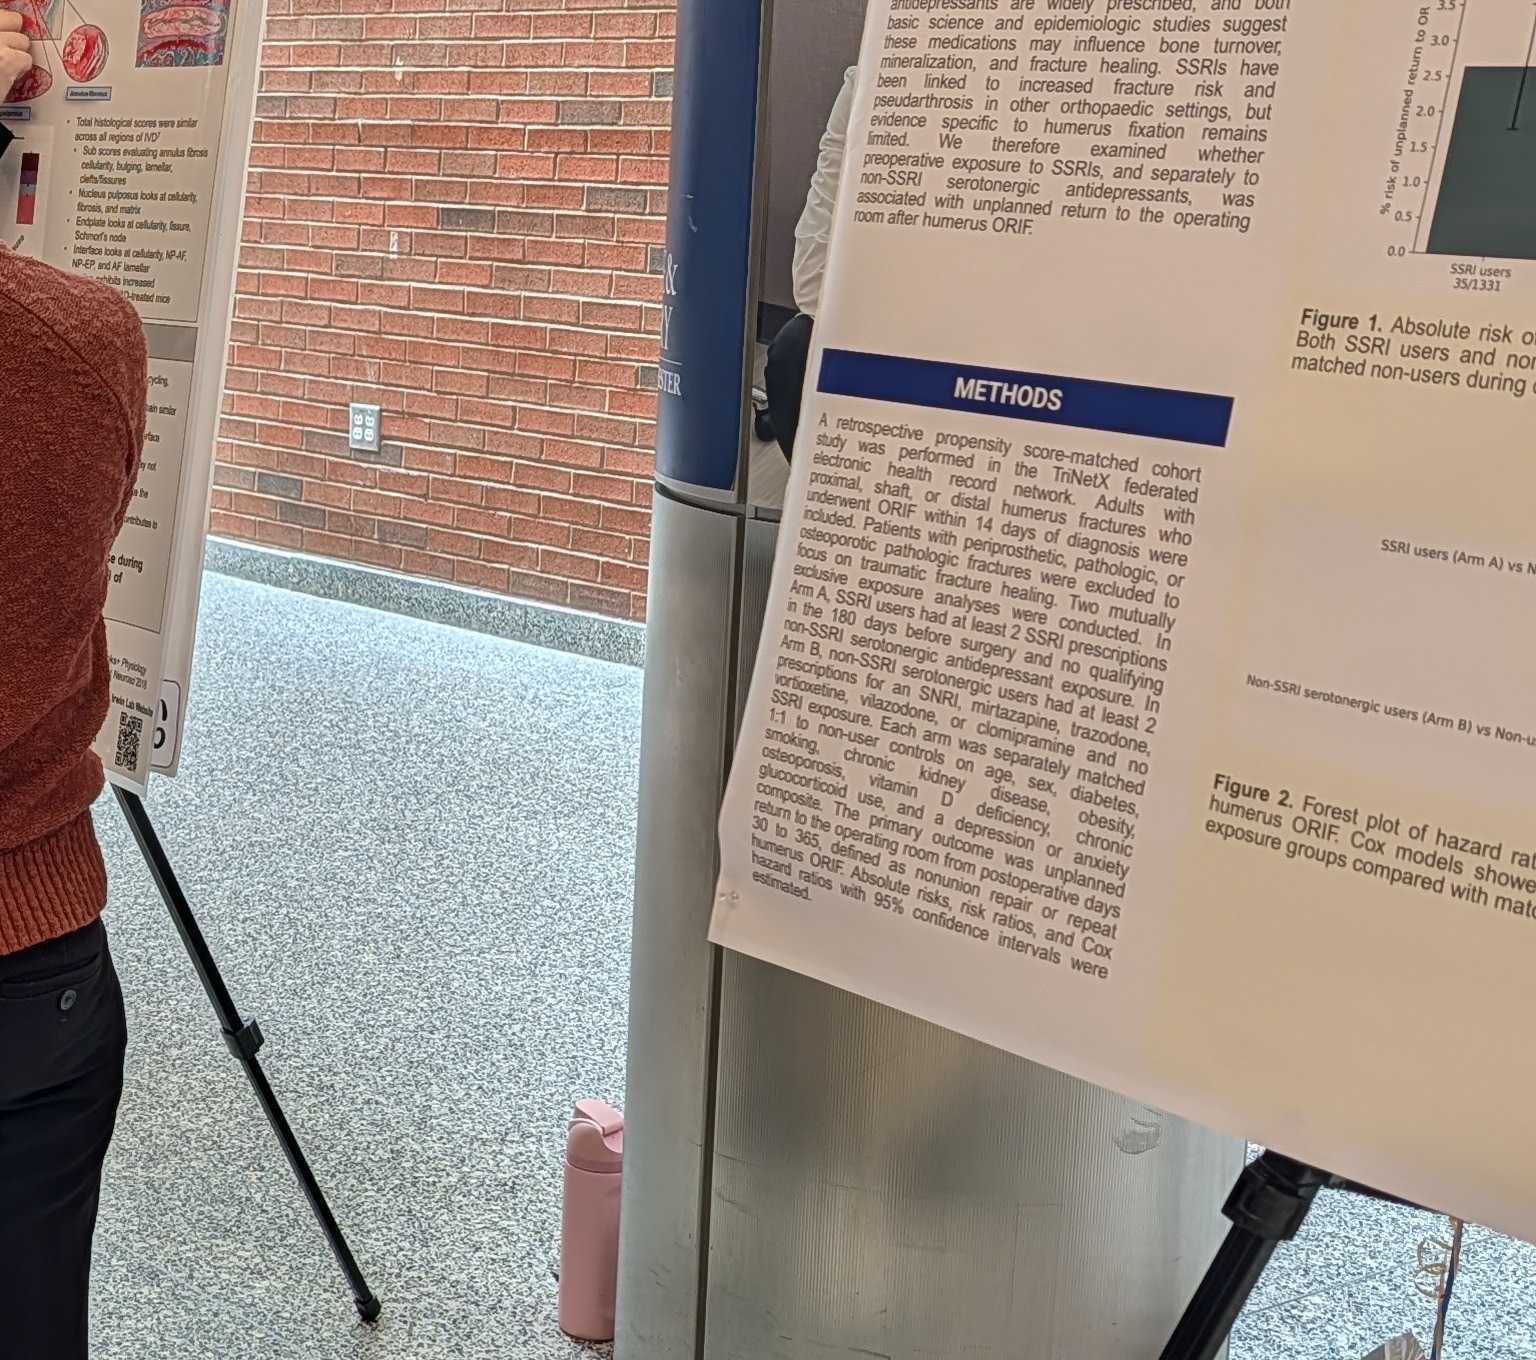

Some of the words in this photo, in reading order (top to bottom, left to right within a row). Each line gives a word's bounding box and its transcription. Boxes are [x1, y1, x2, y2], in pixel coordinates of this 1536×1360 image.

[1449, 262, 1477, 276] SSRI
[1479, 267, 1512, 279] users
[1300, 308, 1360, 332] Figure
[1368, 313, 1382, 333] 1.
[1389, 315, 1471, 340] Absolute
[1478, 323, 1514, 344] risk
[953, 377, 1063, 411] METHODS
[1213, 772, 1271, 802] Figure
[1277, 789, 1294, 809] 2.
[1302, 794, 1359, 825] Forest
[1365, 812, 1401, 836] plot
[1408, 823, 1430, 843] of
[1435, 826, 1503, 861] hazard
